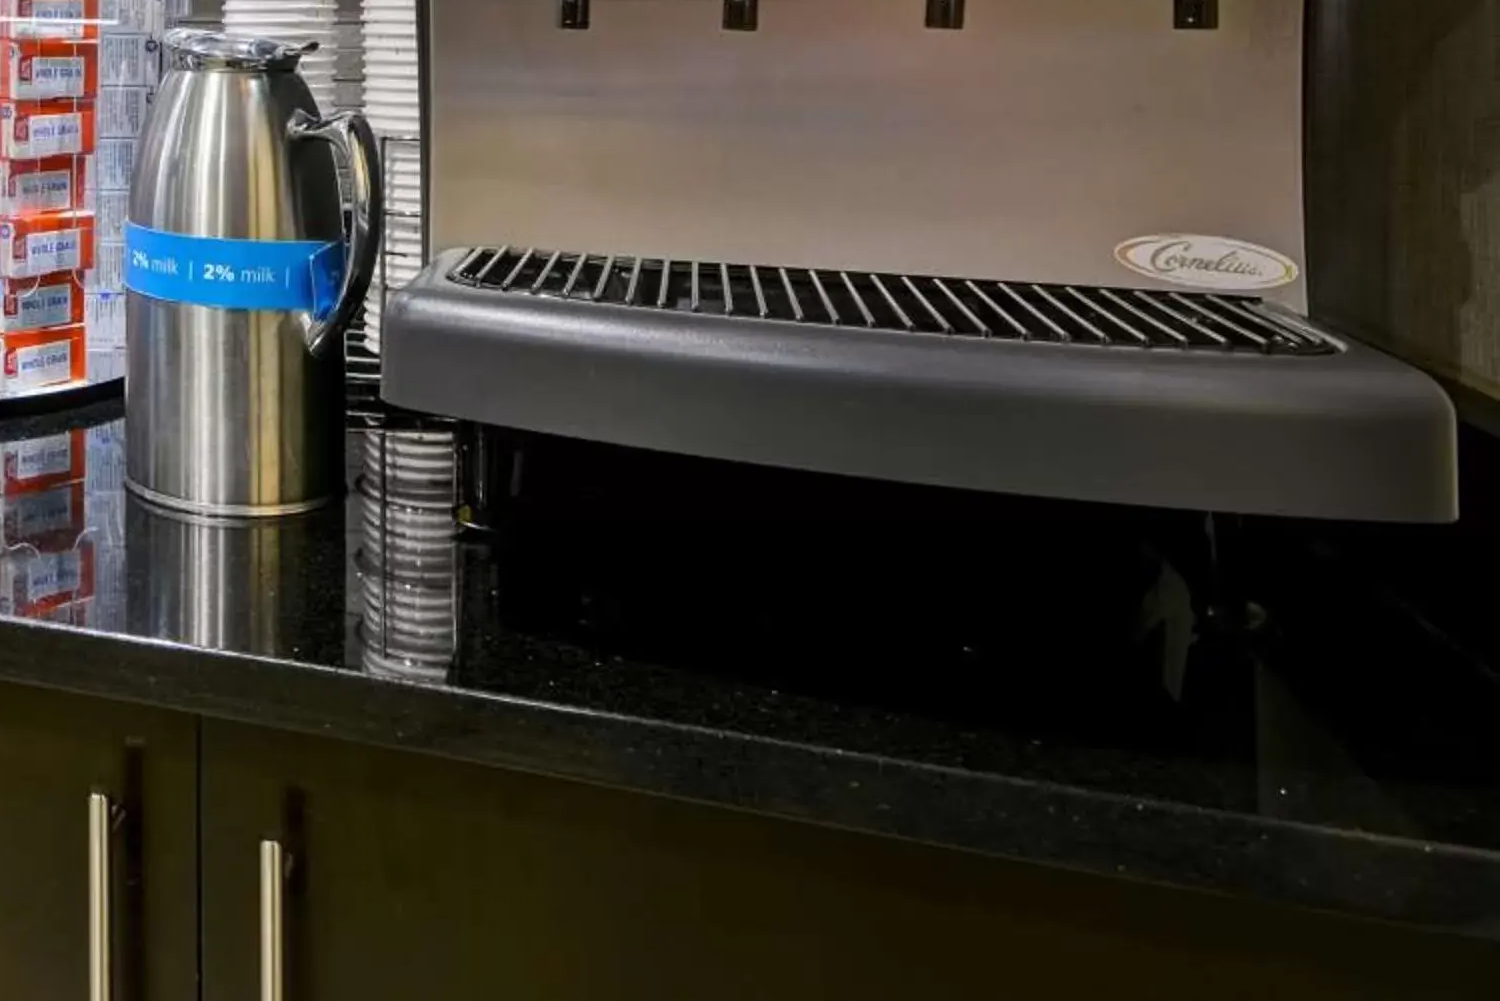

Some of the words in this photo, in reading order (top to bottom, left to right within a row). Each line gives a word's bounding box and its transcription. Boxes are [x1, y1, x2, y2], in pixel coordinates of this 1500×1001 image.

[150, 255, 179, 276] milk
[203, 263, 236, 283] 2%
[240, 265, 277, 283] milk
